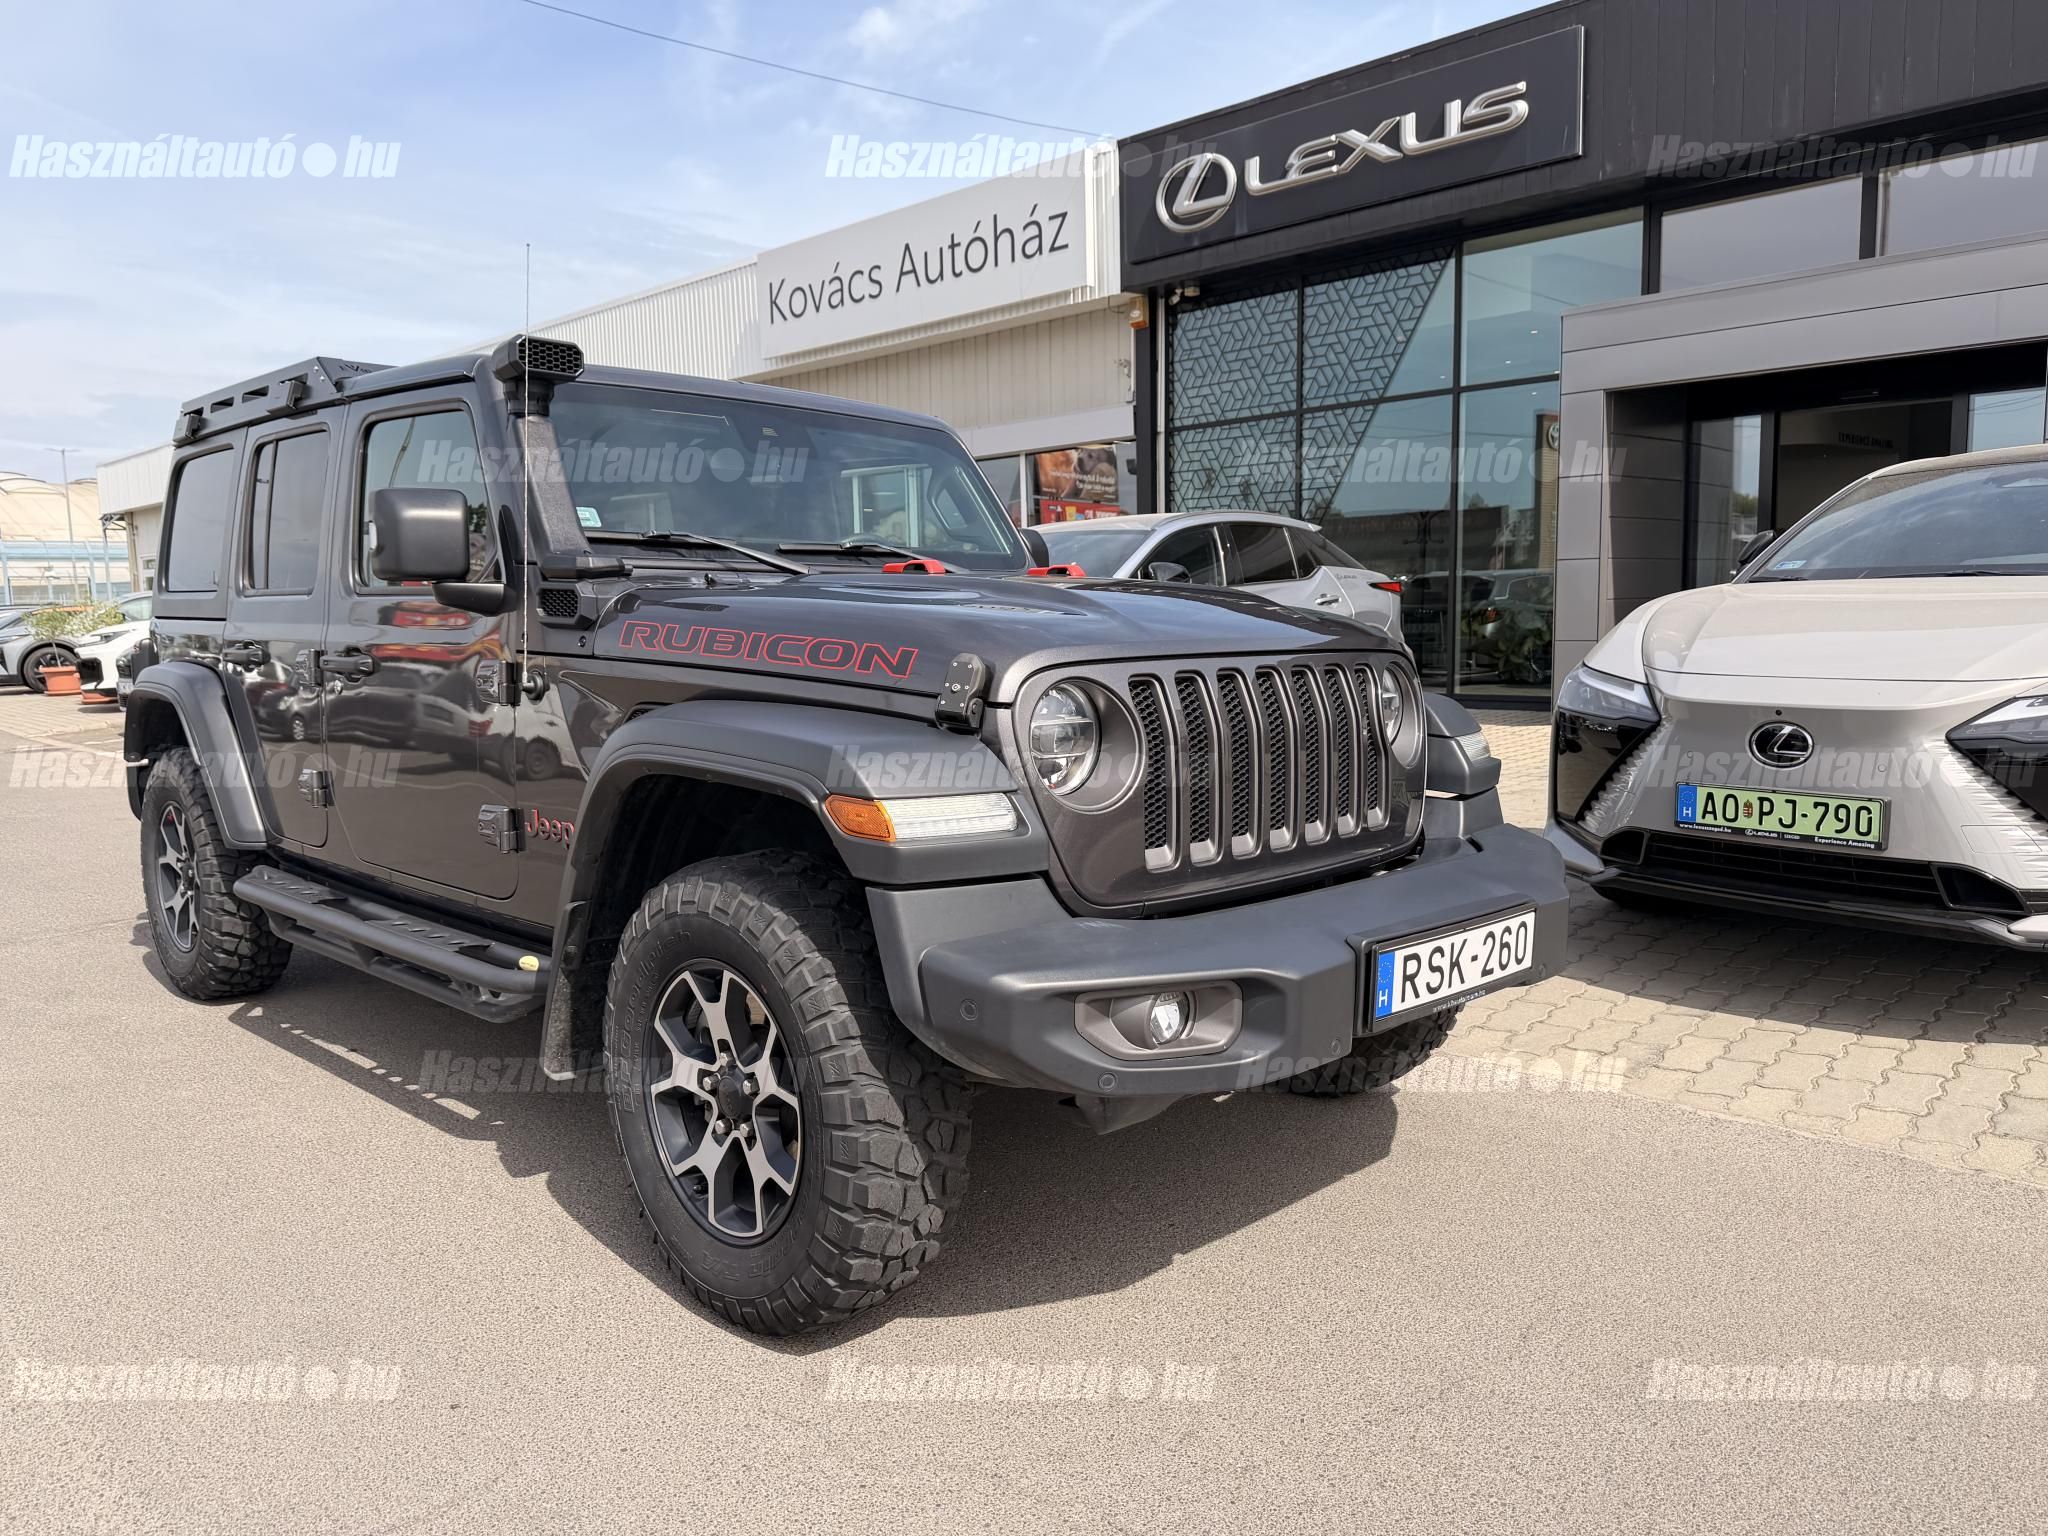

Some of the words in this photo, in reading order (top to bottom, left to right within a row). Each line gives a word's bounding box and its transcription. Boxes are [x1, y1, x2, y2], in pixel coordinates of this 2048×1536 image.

[1244, 81, 1529, 196] LEXUS
[768, 262, 883, 324] Kovács
[895, 203, 1070, 293] Autóház
[618, 620, 919, 678] RUBICON
[524, 806, 575, 850] Jeep
[1701, 791, 1739, 823] AO
[1757, 796, 1873, 837] PJ-790
[1814, 836, 1847, 847] Experience
[1848, 840, 1875, 849] Amazing
[1378, 989, 1389, 1008] H
[1401, 920, 1528, 1003] RSK-260
